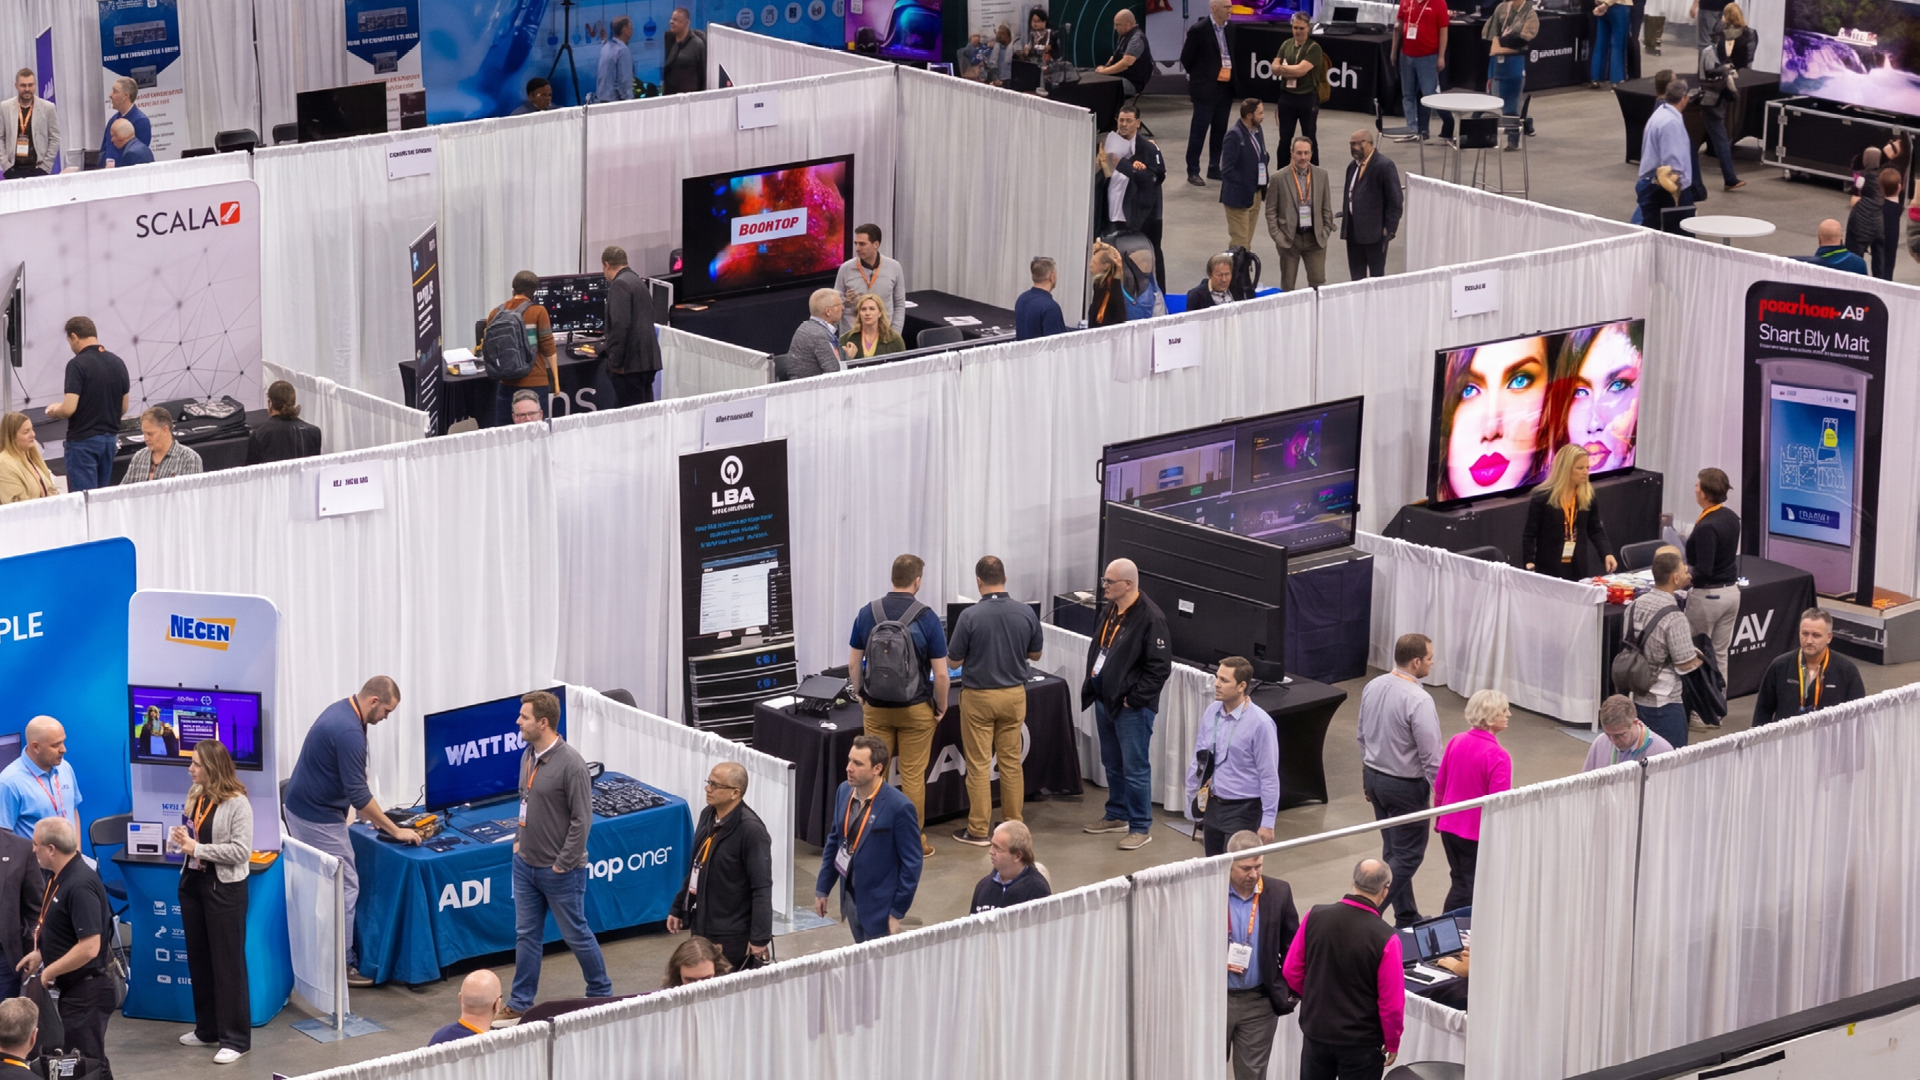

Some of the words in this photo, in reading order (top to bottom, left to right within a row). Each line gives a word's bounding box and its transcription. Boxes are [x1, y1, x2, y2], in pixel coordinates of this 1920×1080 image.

[136, 205, 220, 239] SCALA
[711, 486, 756, 508] LBA
[170, 613, 230, 642] NECEN
[1732, 608, 1775, 648] AV
[444, 734, 503, 766] WATT
[438, 877, 492, 913] ADI
